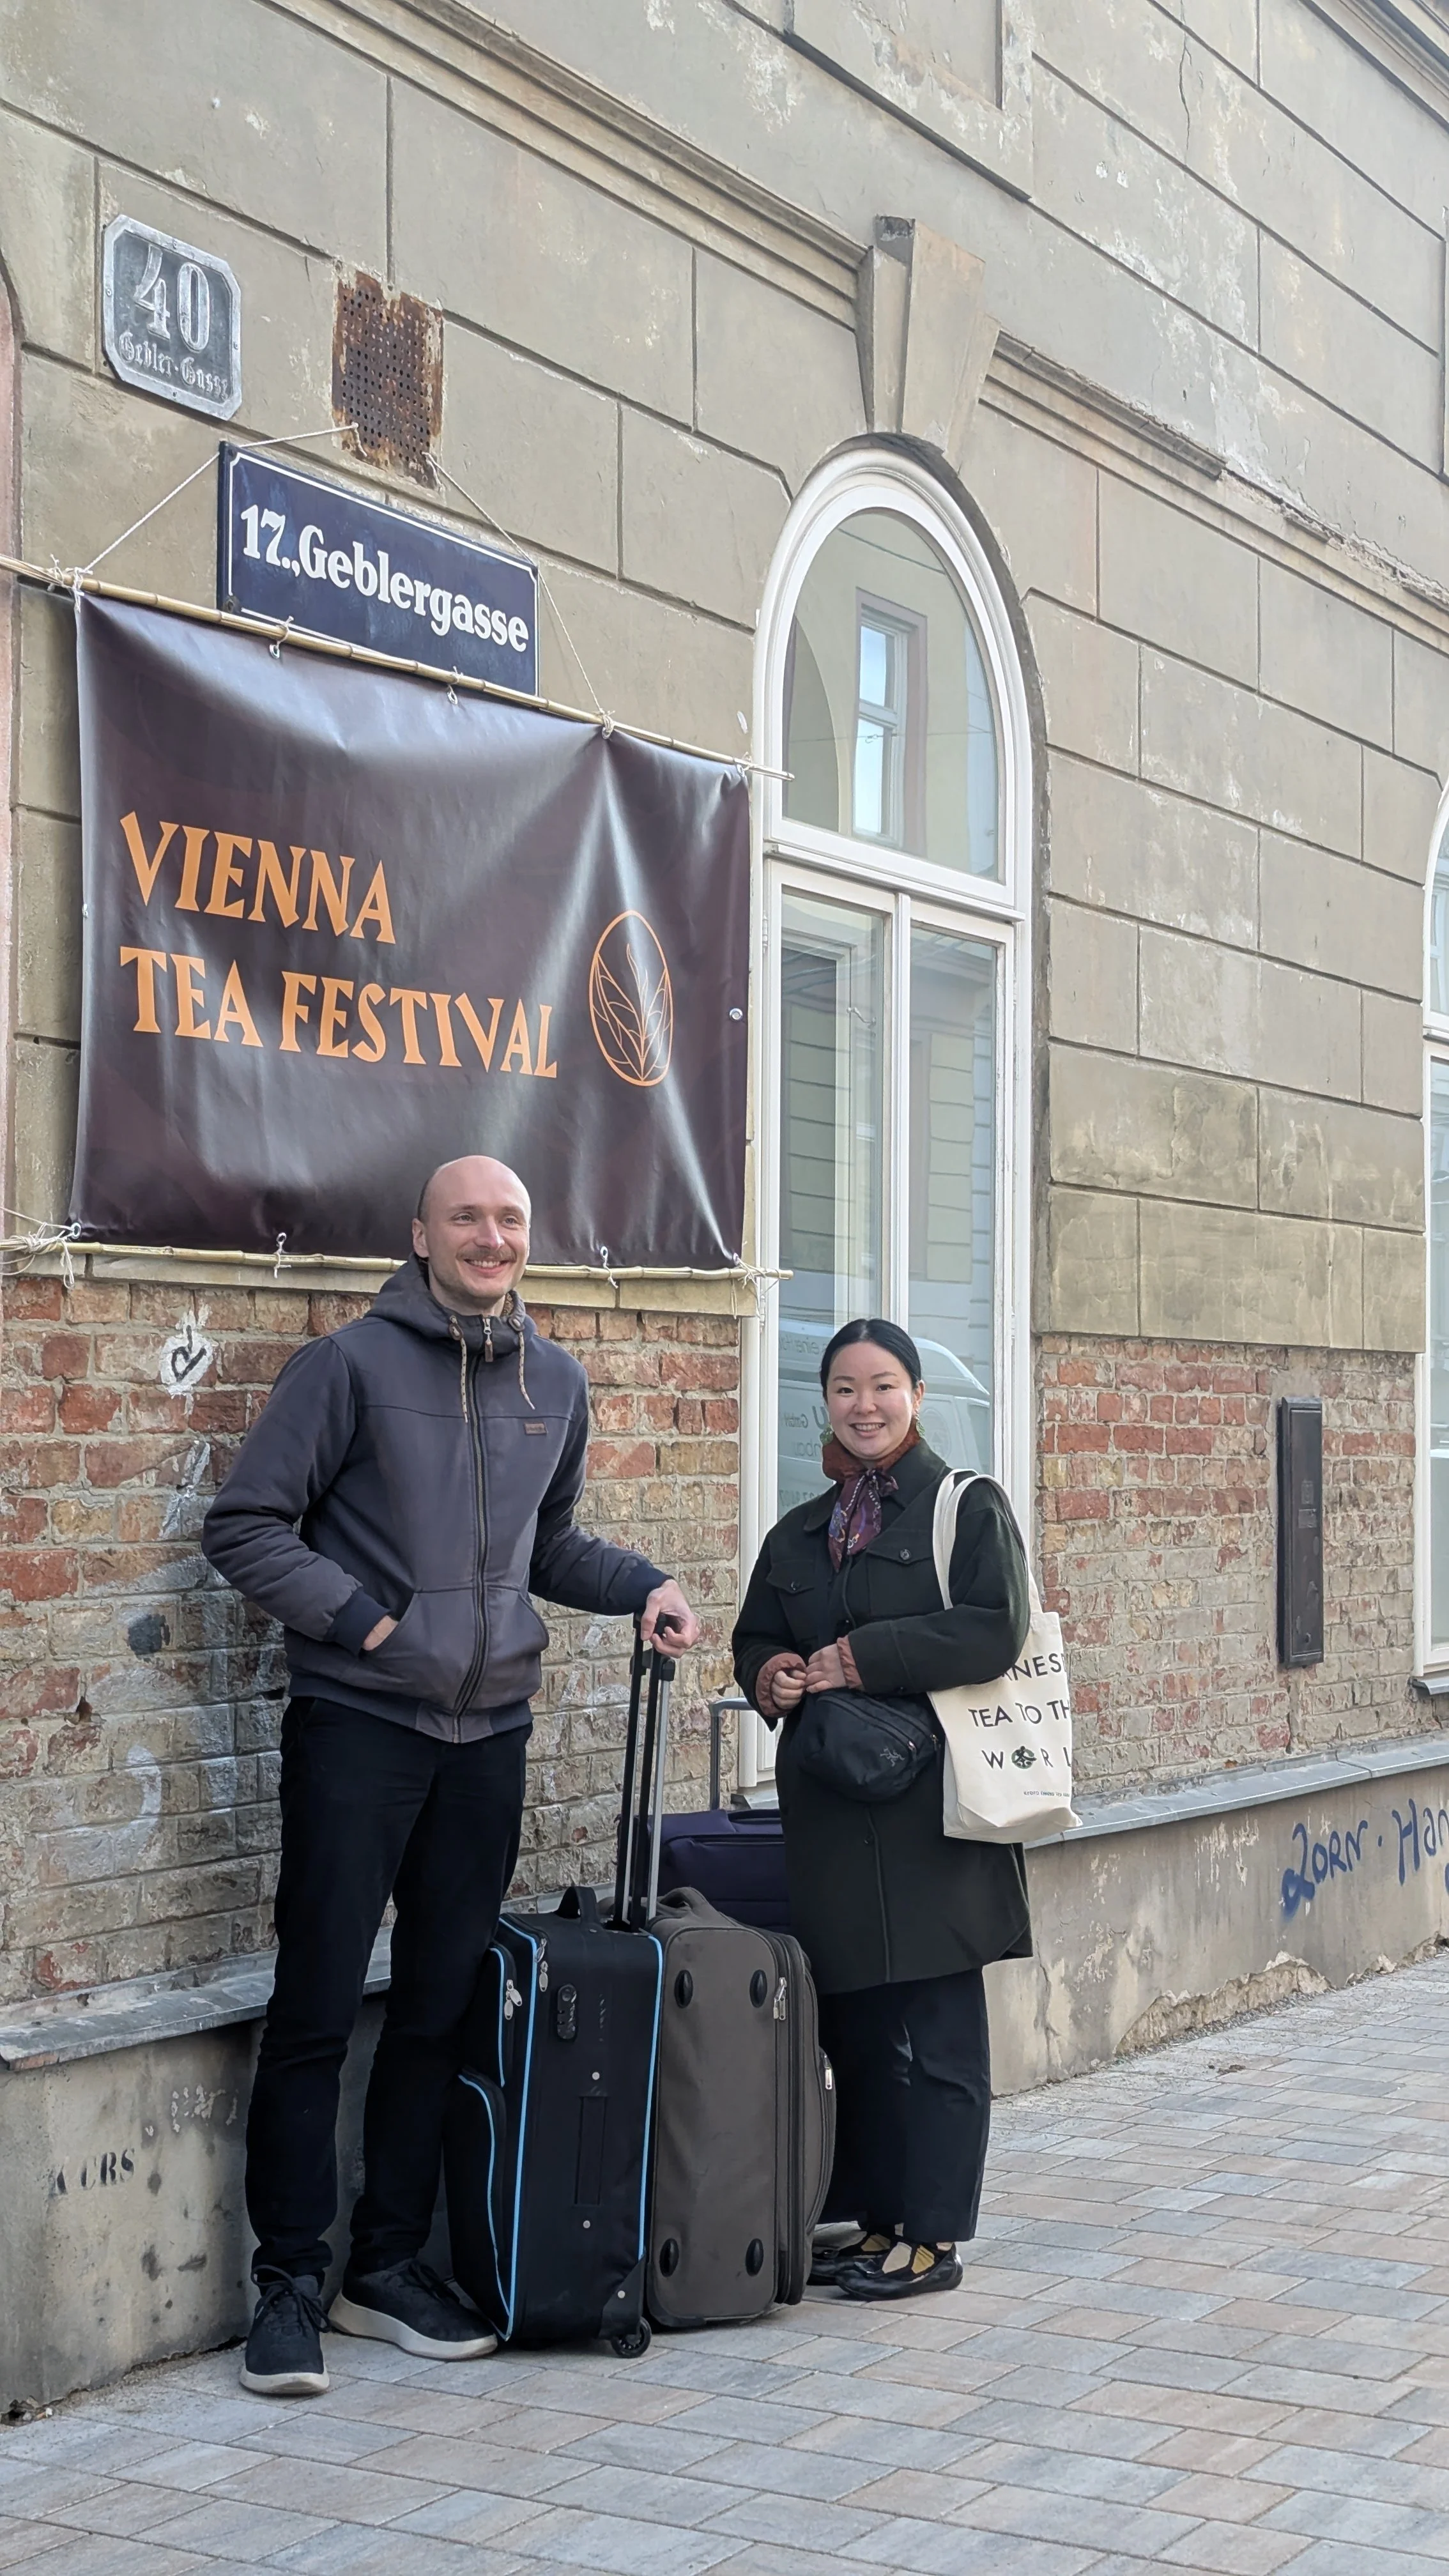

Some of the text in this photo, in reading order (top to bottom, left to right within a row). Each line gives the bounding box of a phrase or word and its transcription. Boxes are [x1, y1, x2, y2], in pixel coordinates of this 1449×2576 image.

[134, 244, 210, 352] 40
[120, 811, 395, 944] VIENNA
[120, 946, 557, 1078] TEA FESTIVAL
[968, 1705, 1013, 1728] TEA
[1015, 1702, 1042, 1724] TO
[1002, 1653, 1066, 1682] NES
